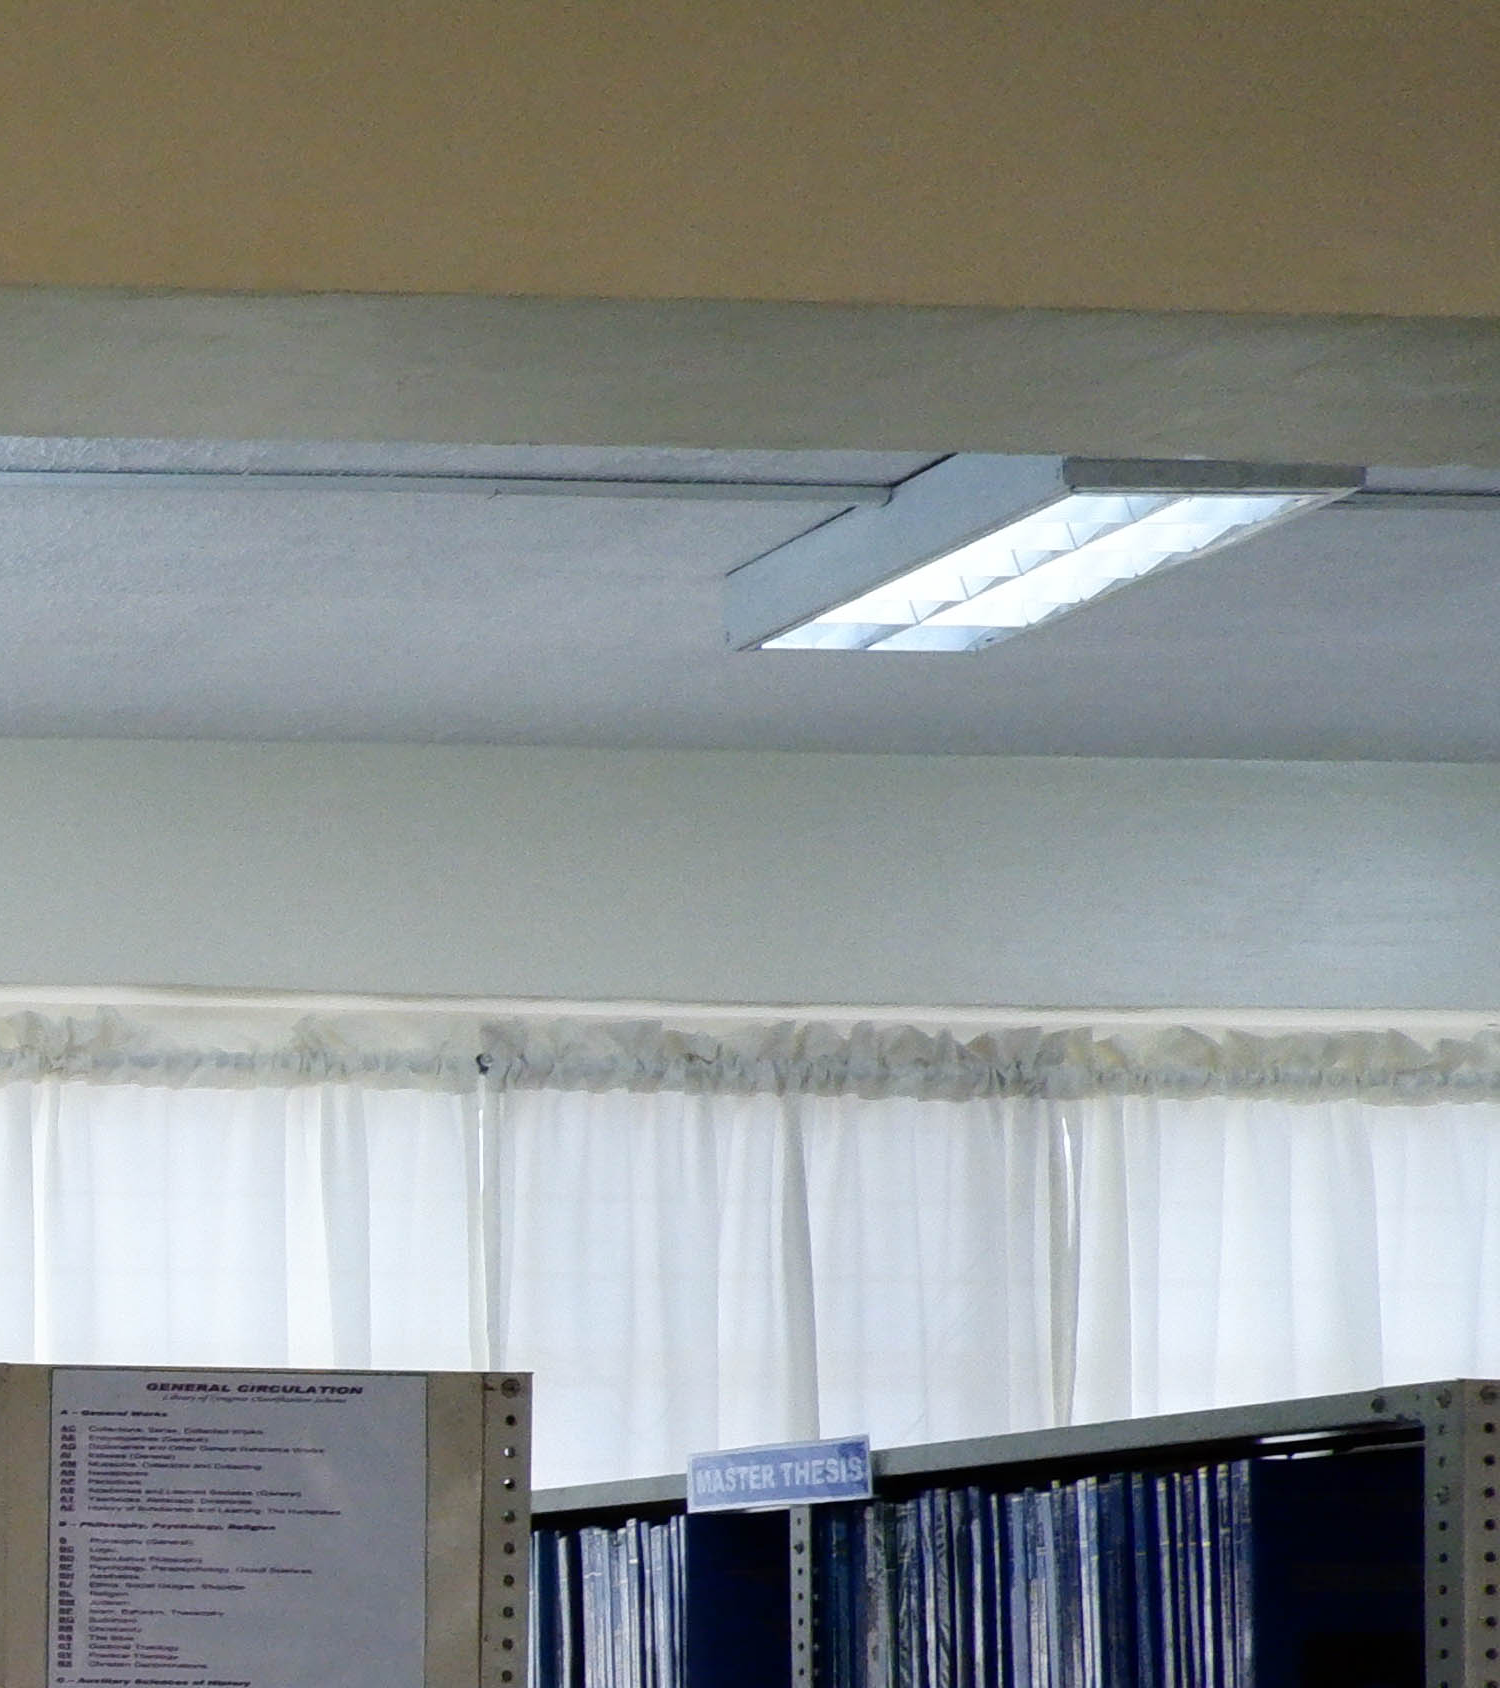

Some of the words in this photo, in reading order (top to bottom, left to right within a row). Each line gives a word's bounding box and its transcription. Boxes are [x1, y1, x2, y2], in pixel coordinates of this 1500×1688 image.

[146, 1383, 230, 1392] GENERAL
[237, 1385, 363, 1394] CIRCULATION
[694, 1464, 776, 1495] MASTER
[779, 1456, 864, 1488] THESIS
